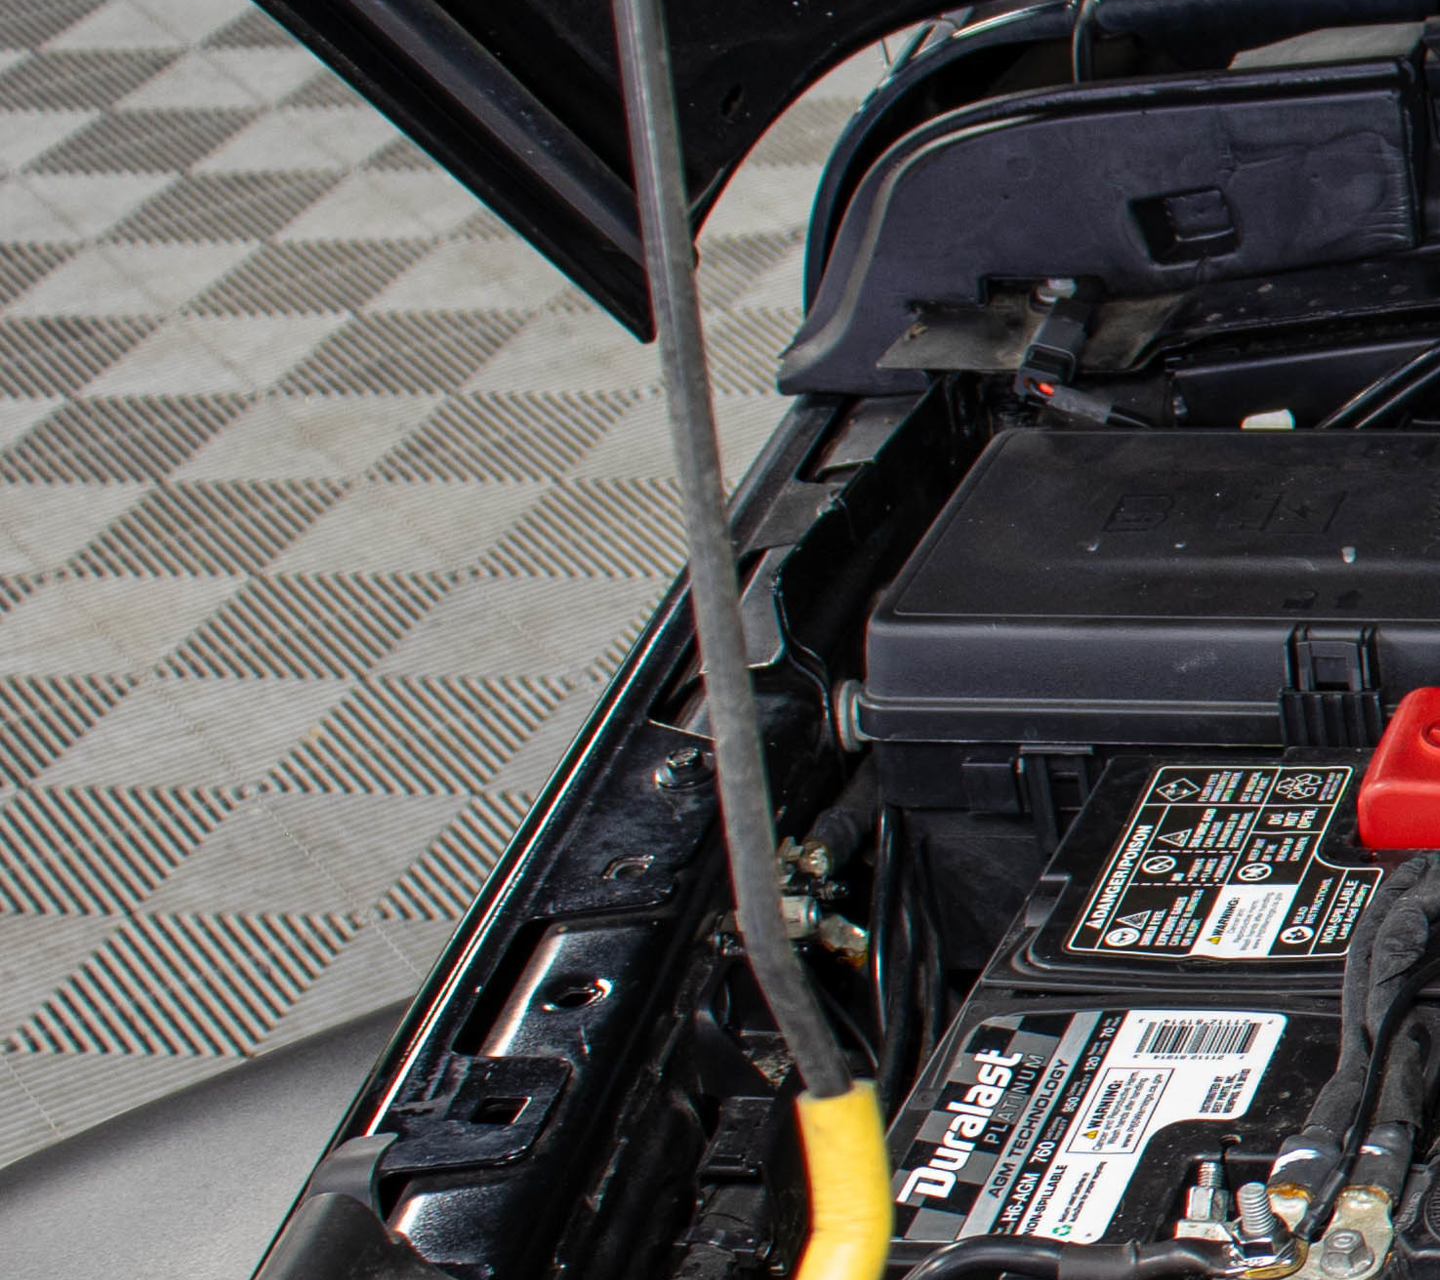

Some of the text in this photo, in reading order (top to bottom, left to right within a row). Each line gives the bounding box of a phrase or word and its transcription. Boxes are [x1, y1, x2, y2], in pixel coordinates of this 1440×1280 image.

[1265, 813, 1284, 825] DO
[1281, 811, 1299, 827] NOT
[1295, 807, 1317, 829] OPEN.
[1096, 824, 1154, 920] DANGER/POISON
[1210, 896, 1239, 936] WARNING:
[1291, 905, 1308, 924] READ
[1319, 879, 1358, 944] NON-SPILLABLE
[1335, 883, 1370, 939] Lead Acid Battery
[896, 1049, 1024, 1203] Duralast
[983, 1053, 1046, 1144] PLATINUM
[1001, 1173, 1040, 1223] H6-AGM
[1029, 1140, 1055, 1165] 760
[1061, 1096, 1081, 1115] 950
[1083, 1055, 1101, 1073] 120
[1101, 1024, 1117, 1039] 70
[1085, 1079, 1124, 1129] WARNING:
[988, 1163, 1018, 1200] AGM
[1011, 1058, 1071, 1158] TECHNOLOGY
[1024, 1164, 1068, 1236] NON-SPILLABLE
